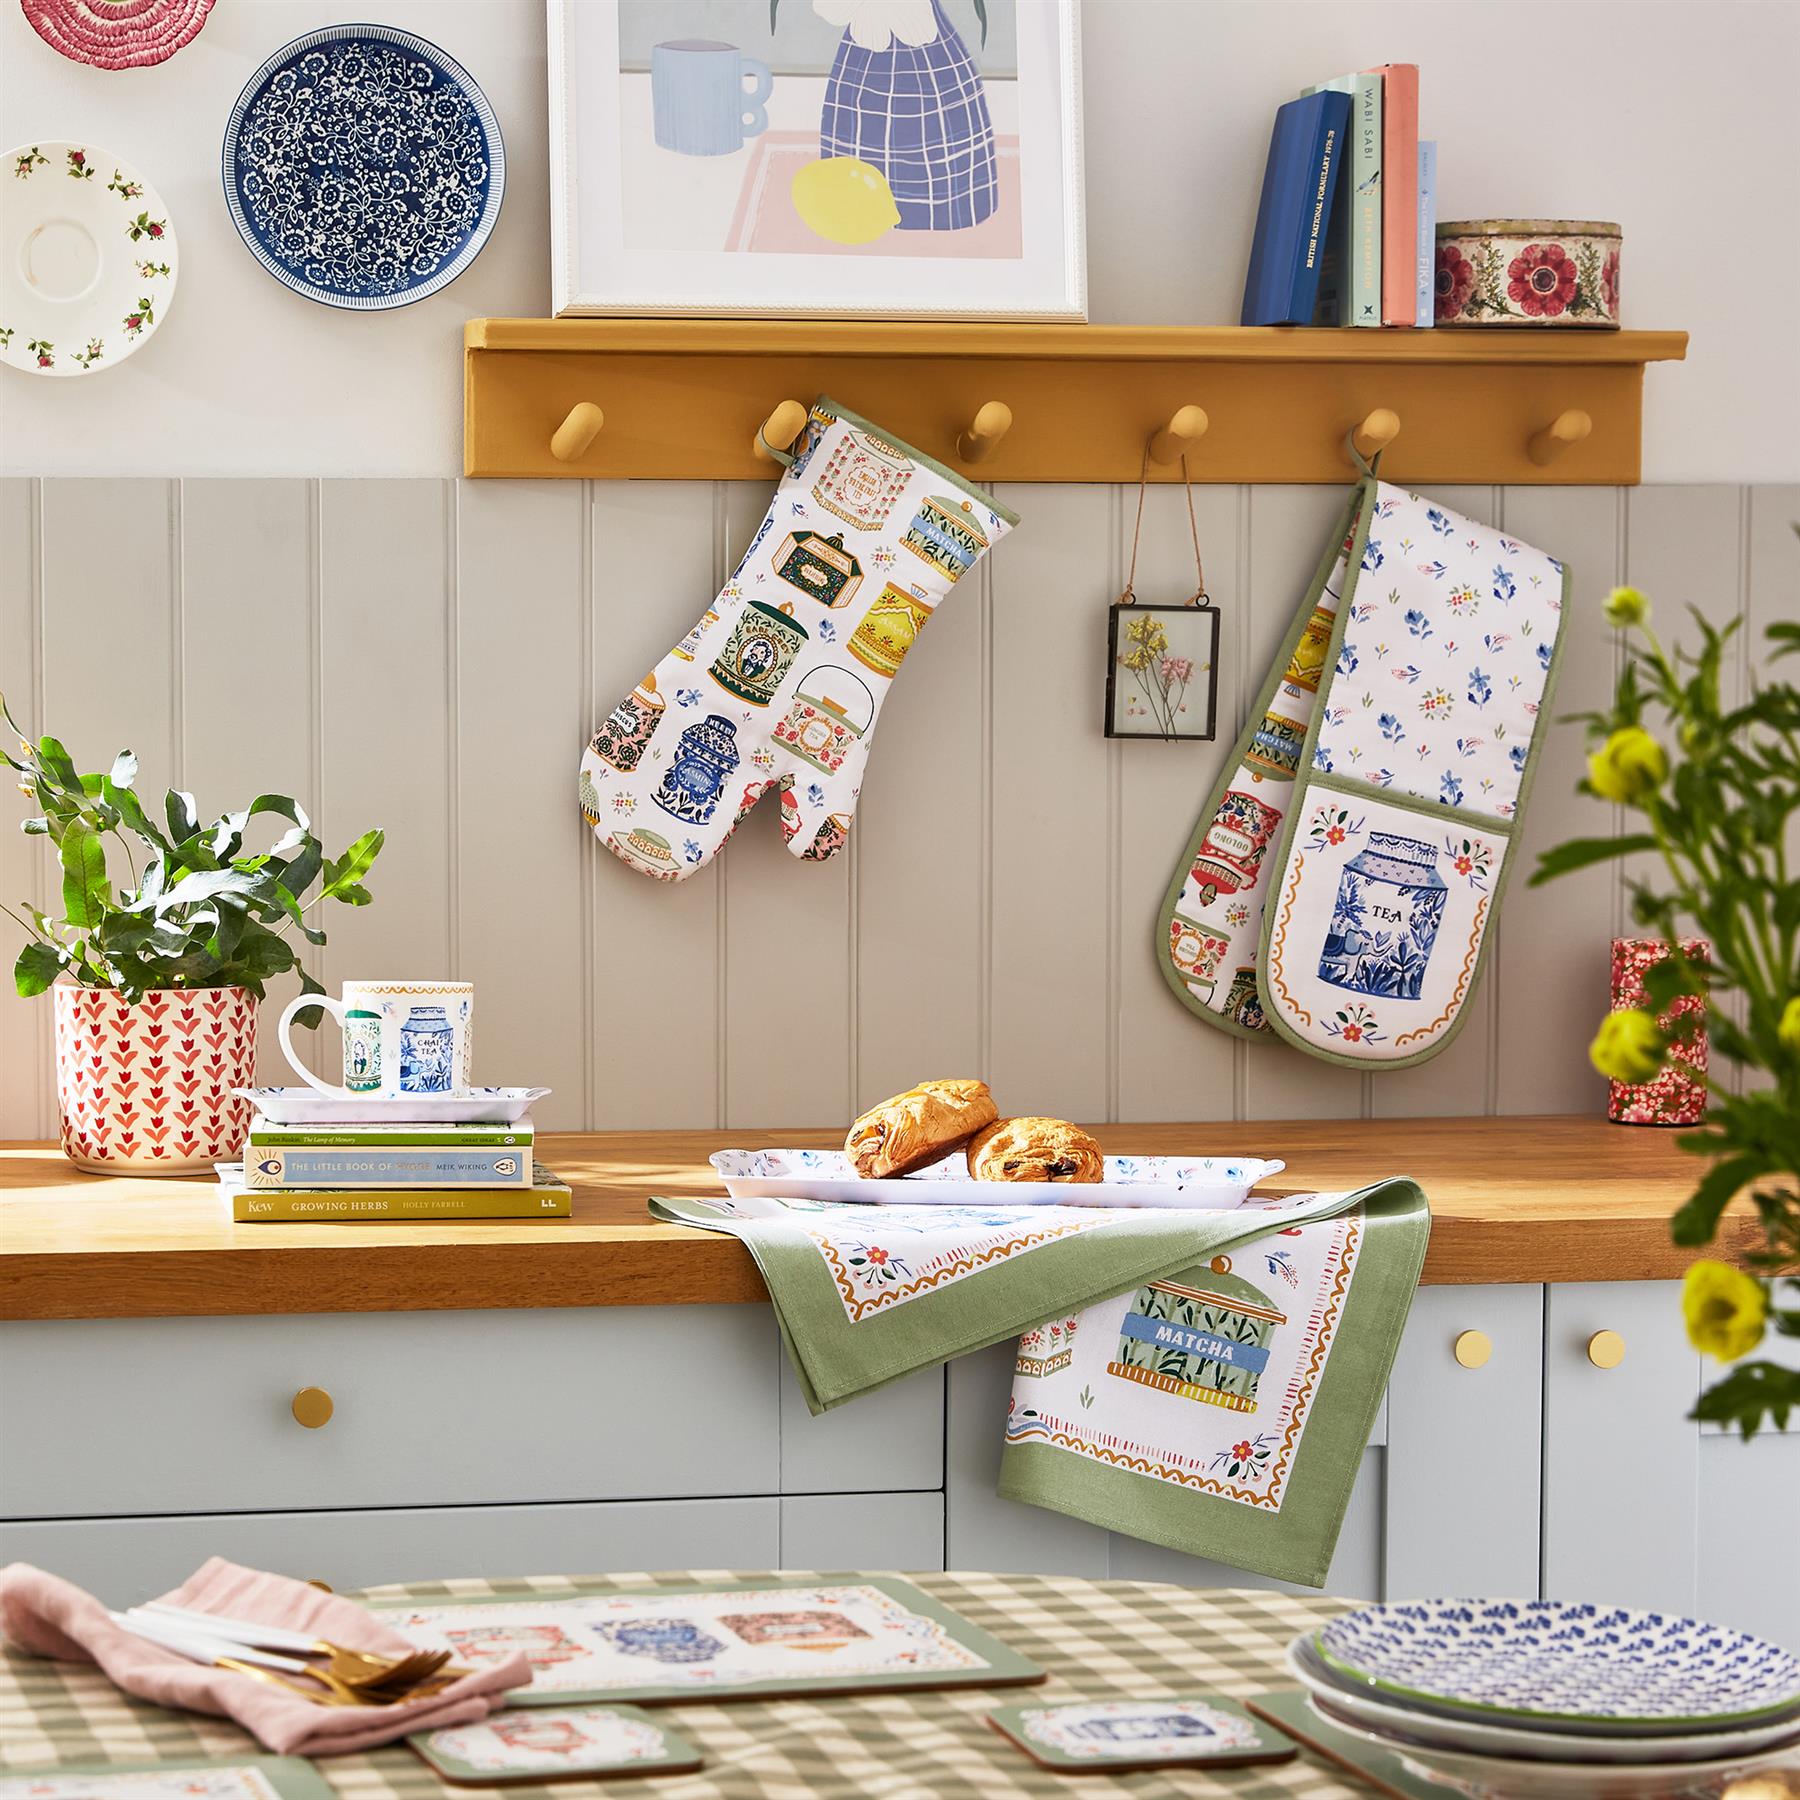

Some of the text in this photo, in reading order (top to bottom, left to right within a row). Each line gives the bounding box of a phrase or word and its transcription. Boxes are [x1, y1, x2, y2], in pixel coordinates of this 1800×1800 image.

[1364, 88, 1374, 158] WABI SABI
[1317, 155, 1331, 200] FORMULARY
[1311, 201, 1324, 238] NATIONAL
[1306, 238, 1318, 268] BRITISH
[1418, 257, 1430, 288] FIKA
[926, 527, 962, 558] MATCHA
[1256, 732, 1294, 752] MATCHA
[1214, 832, 1250, 852] OOLONG
[1372, 904, 1402, 923] TEA
[422, 1048, 438, 1056] TEA
[314, 1136, 328, 1144] Lamp
[335, 1136, 356, 1144] Memory
[292, 1162, 308, 1171] THE
[312, 1162, 342, 1171] LITTLE
[346, 1162, 374, 1171] BOOK
[378, 1162, 392, 1171] OF
[248, 1200, 274, 1212] Kew
[292, 1202, 348, 1212] GROWING
[351, 1202, 389, 1210] HERBS
[1155, 1325, 1234, 1361] MATCHA
